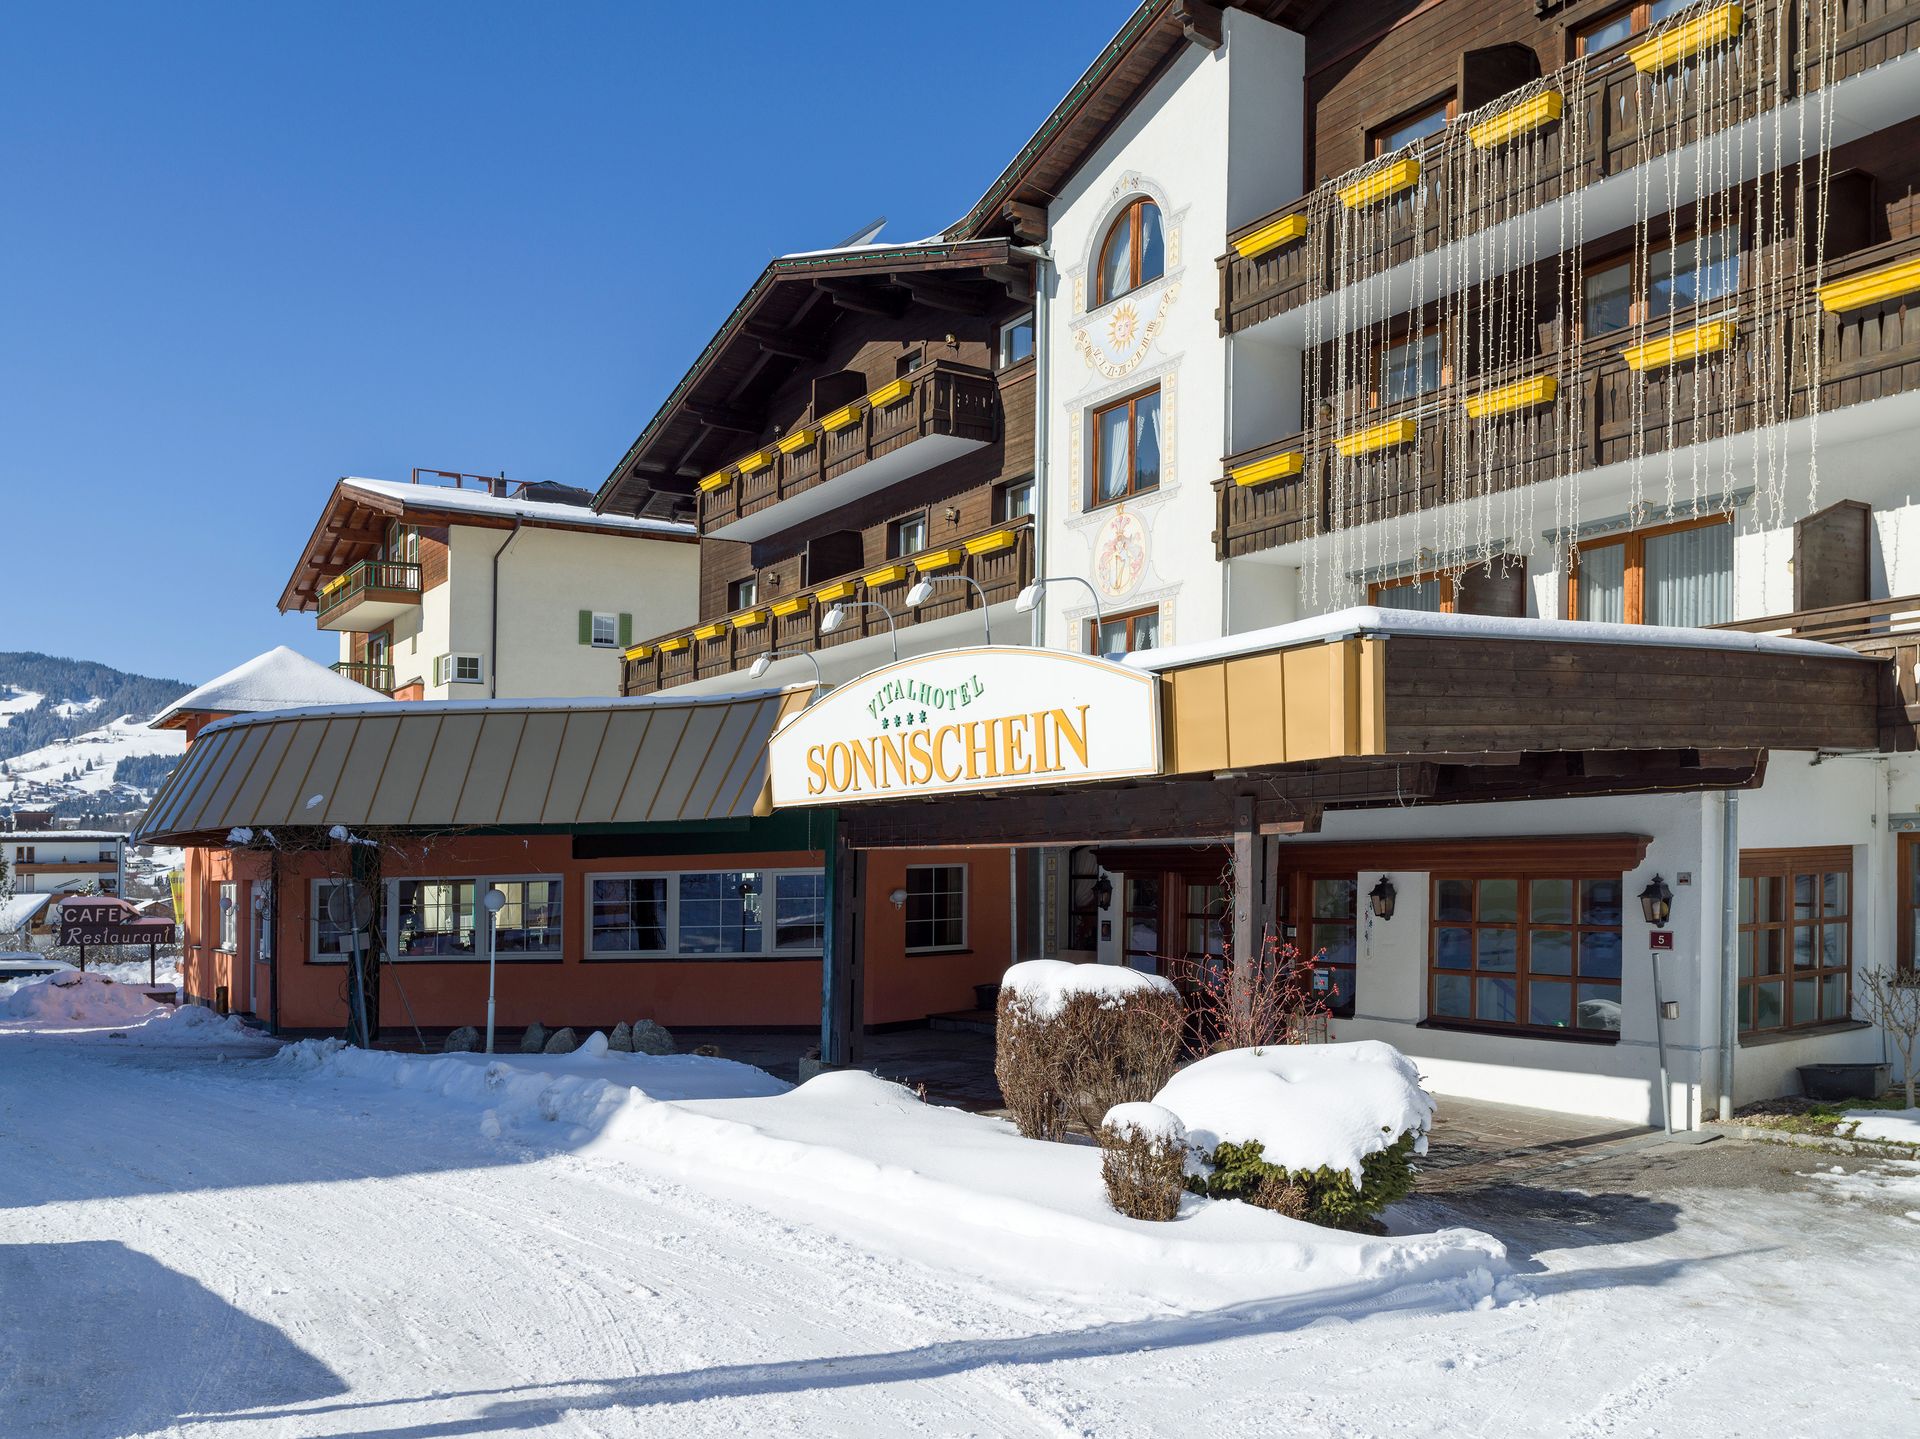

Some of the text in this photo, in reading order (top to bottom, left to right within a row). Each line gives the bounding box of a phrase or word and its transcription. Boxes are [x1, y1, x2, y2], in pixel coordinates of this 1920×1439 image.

[866, 674, 985, 720] VITALHOTEL
[807, 704, 1090, 795] SONNSCHEIN
[64, 908, 118, 922] CAFE
[66, 927, 170, 944] Restaurant
[1658, 935, 1665, 944] 5
